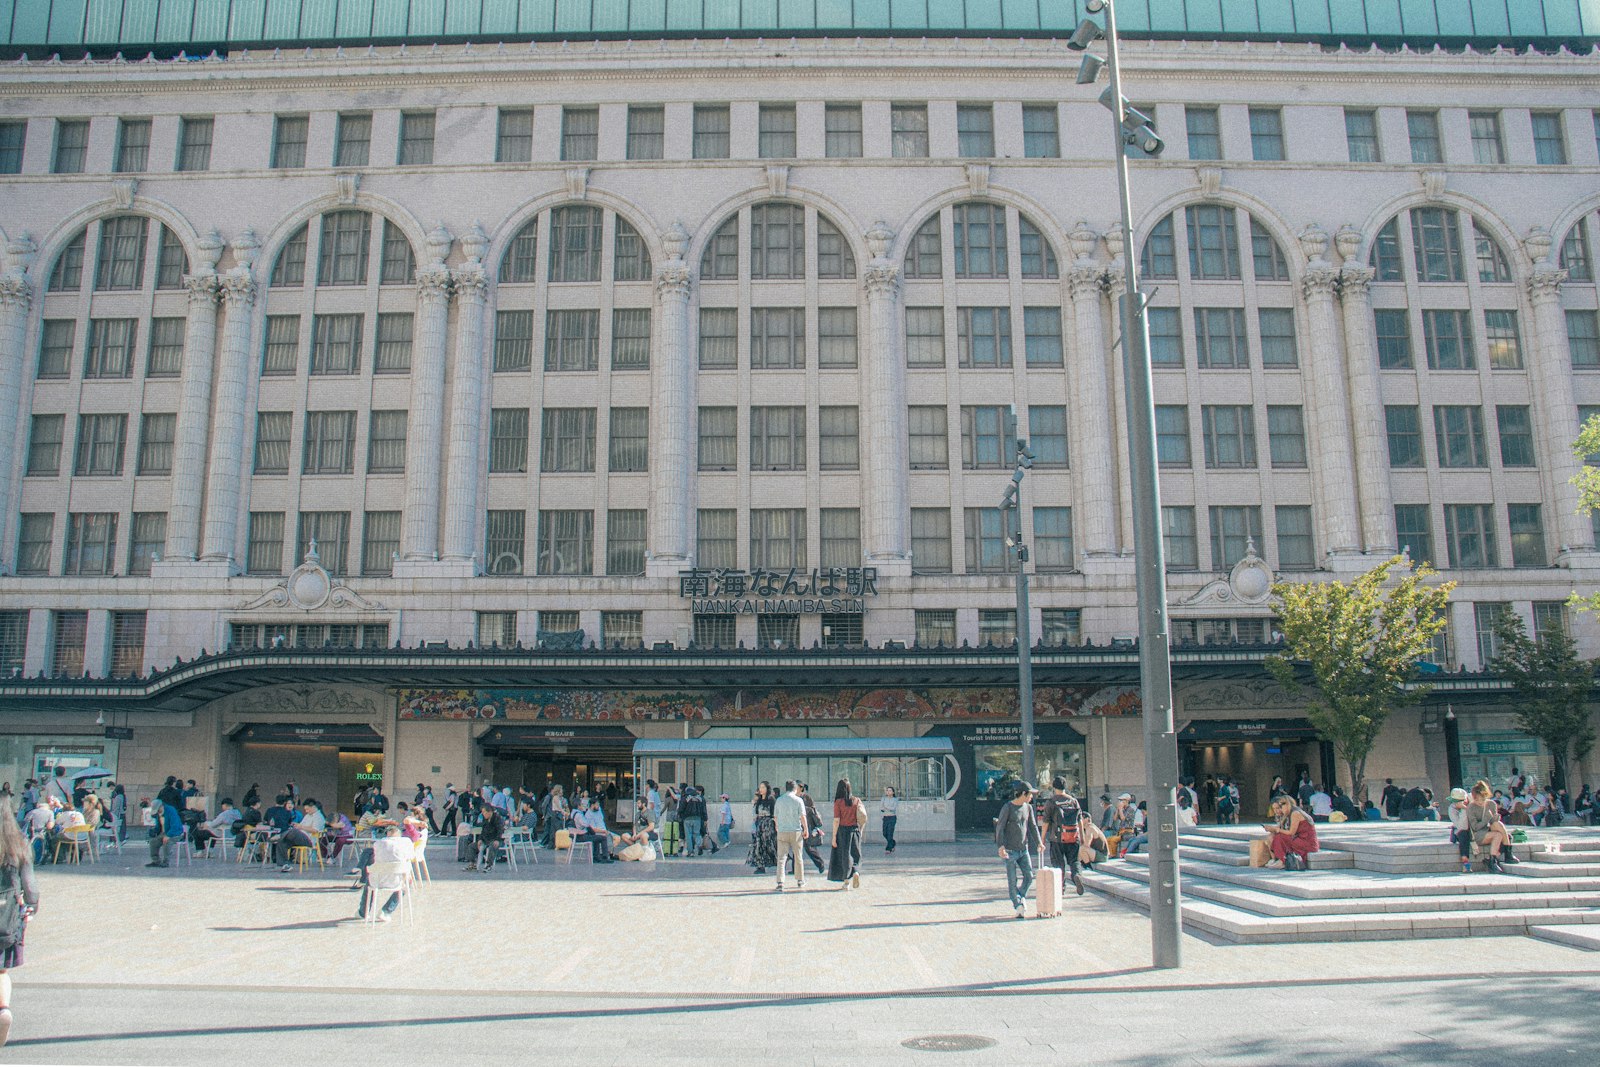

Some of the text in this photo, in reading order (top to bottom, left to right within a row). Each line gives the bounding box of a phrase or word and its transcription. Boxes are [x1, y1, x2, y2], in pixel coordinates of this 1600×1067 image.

[678, 567, 879, 598] 南海なんば駅
[692, 599, 870, 613] NANKAI NAMBA STN.
